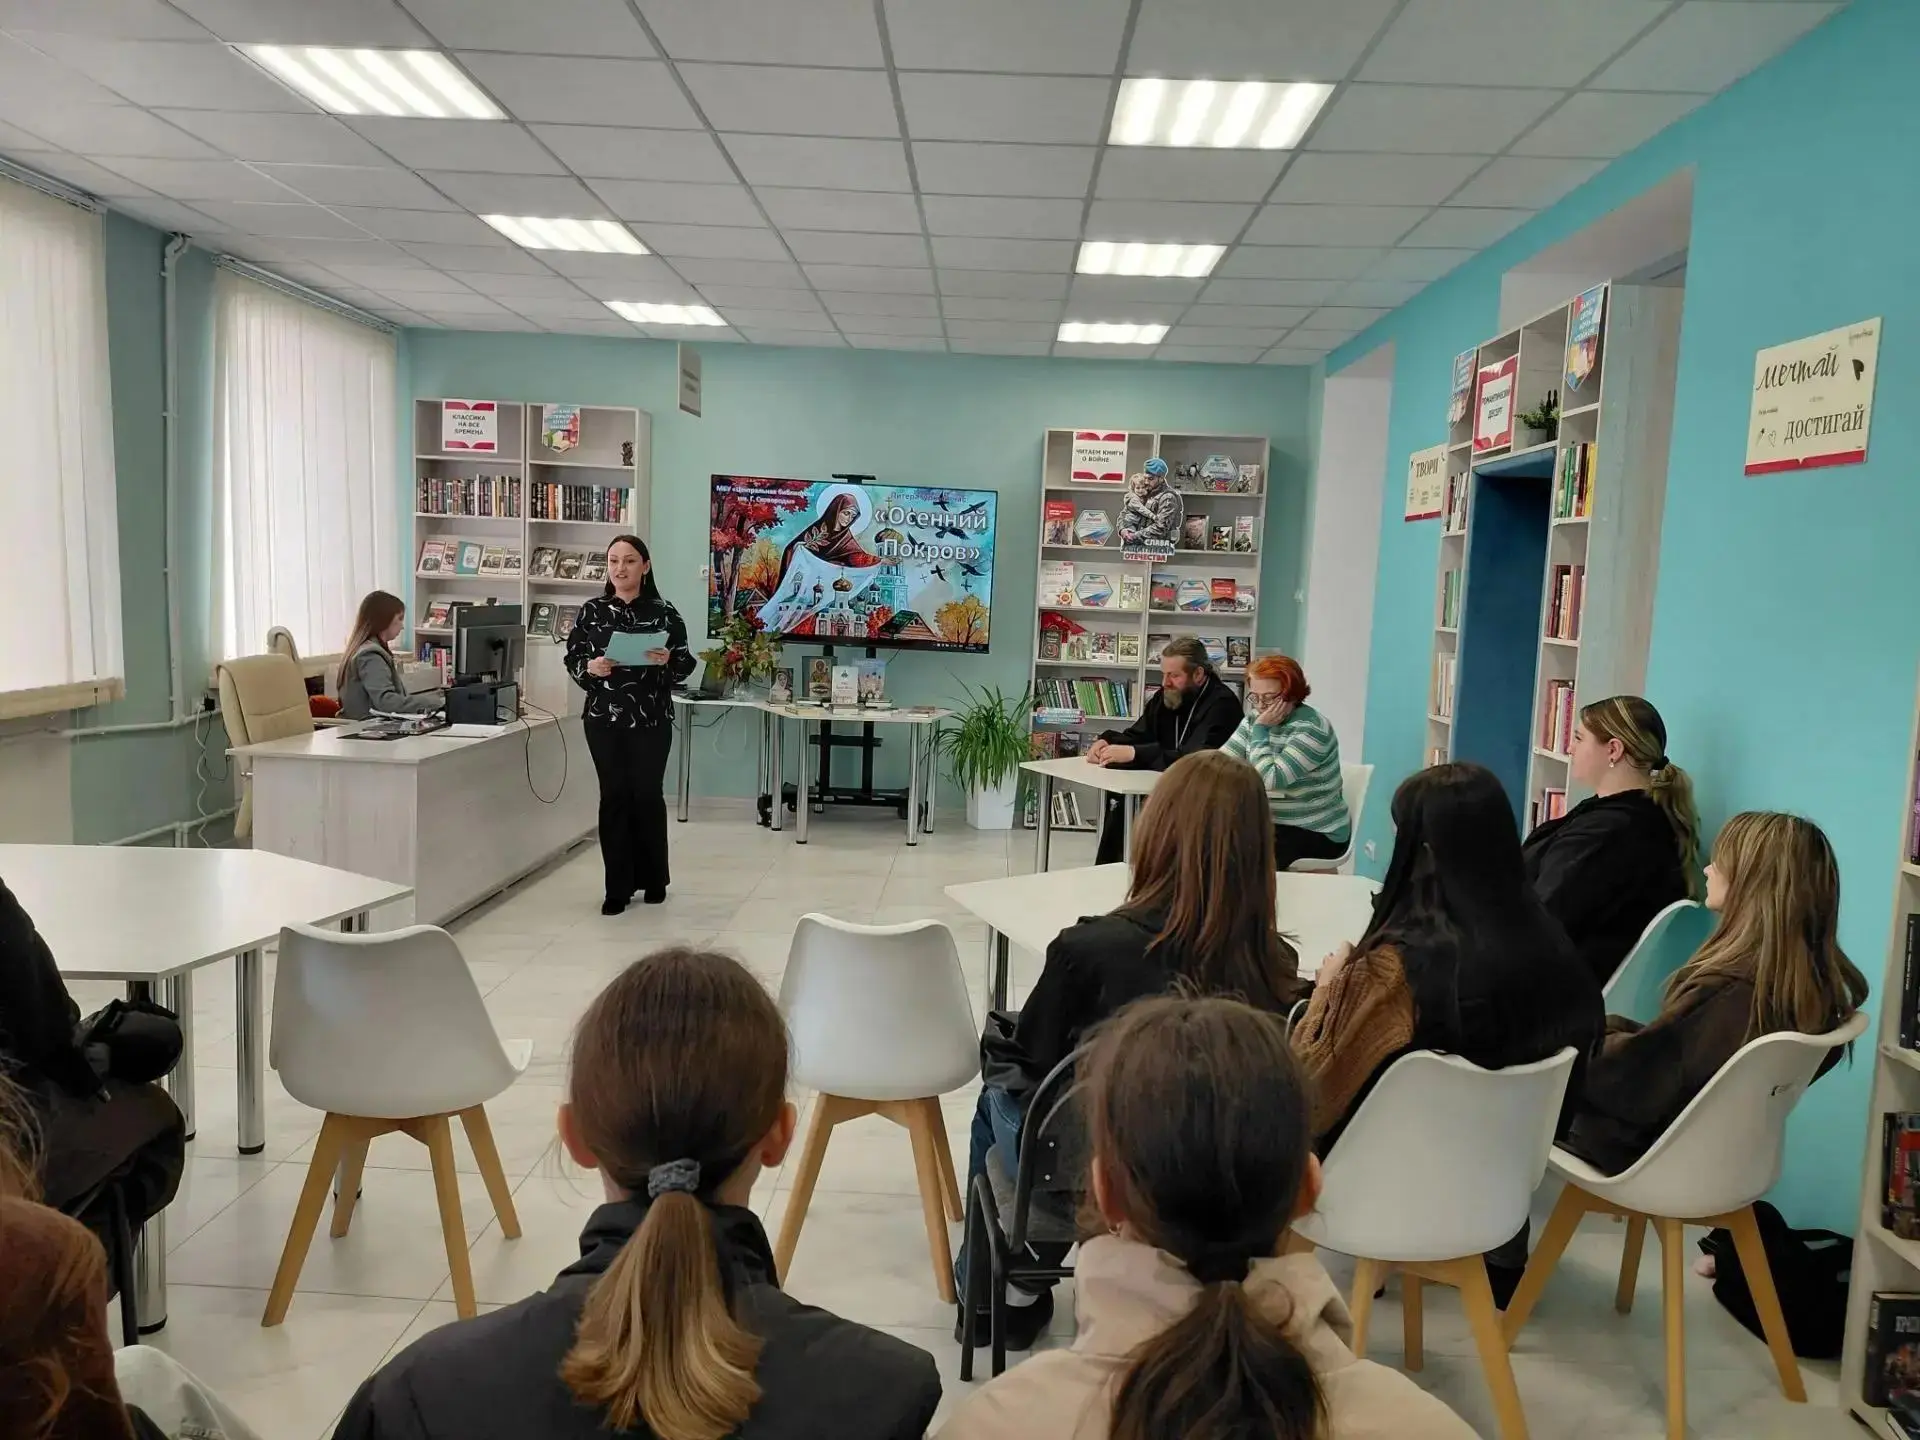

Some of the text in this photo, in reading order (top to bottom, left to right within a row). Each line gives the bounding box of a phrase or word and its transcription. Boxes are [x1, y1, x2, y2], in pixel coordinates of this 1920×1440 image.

[875, 506, 987, 529] «Осенний
[884, 539, 980, 562] Покров»
[1124, 553, 1165, 561] ОТЕЧЕСТВА
